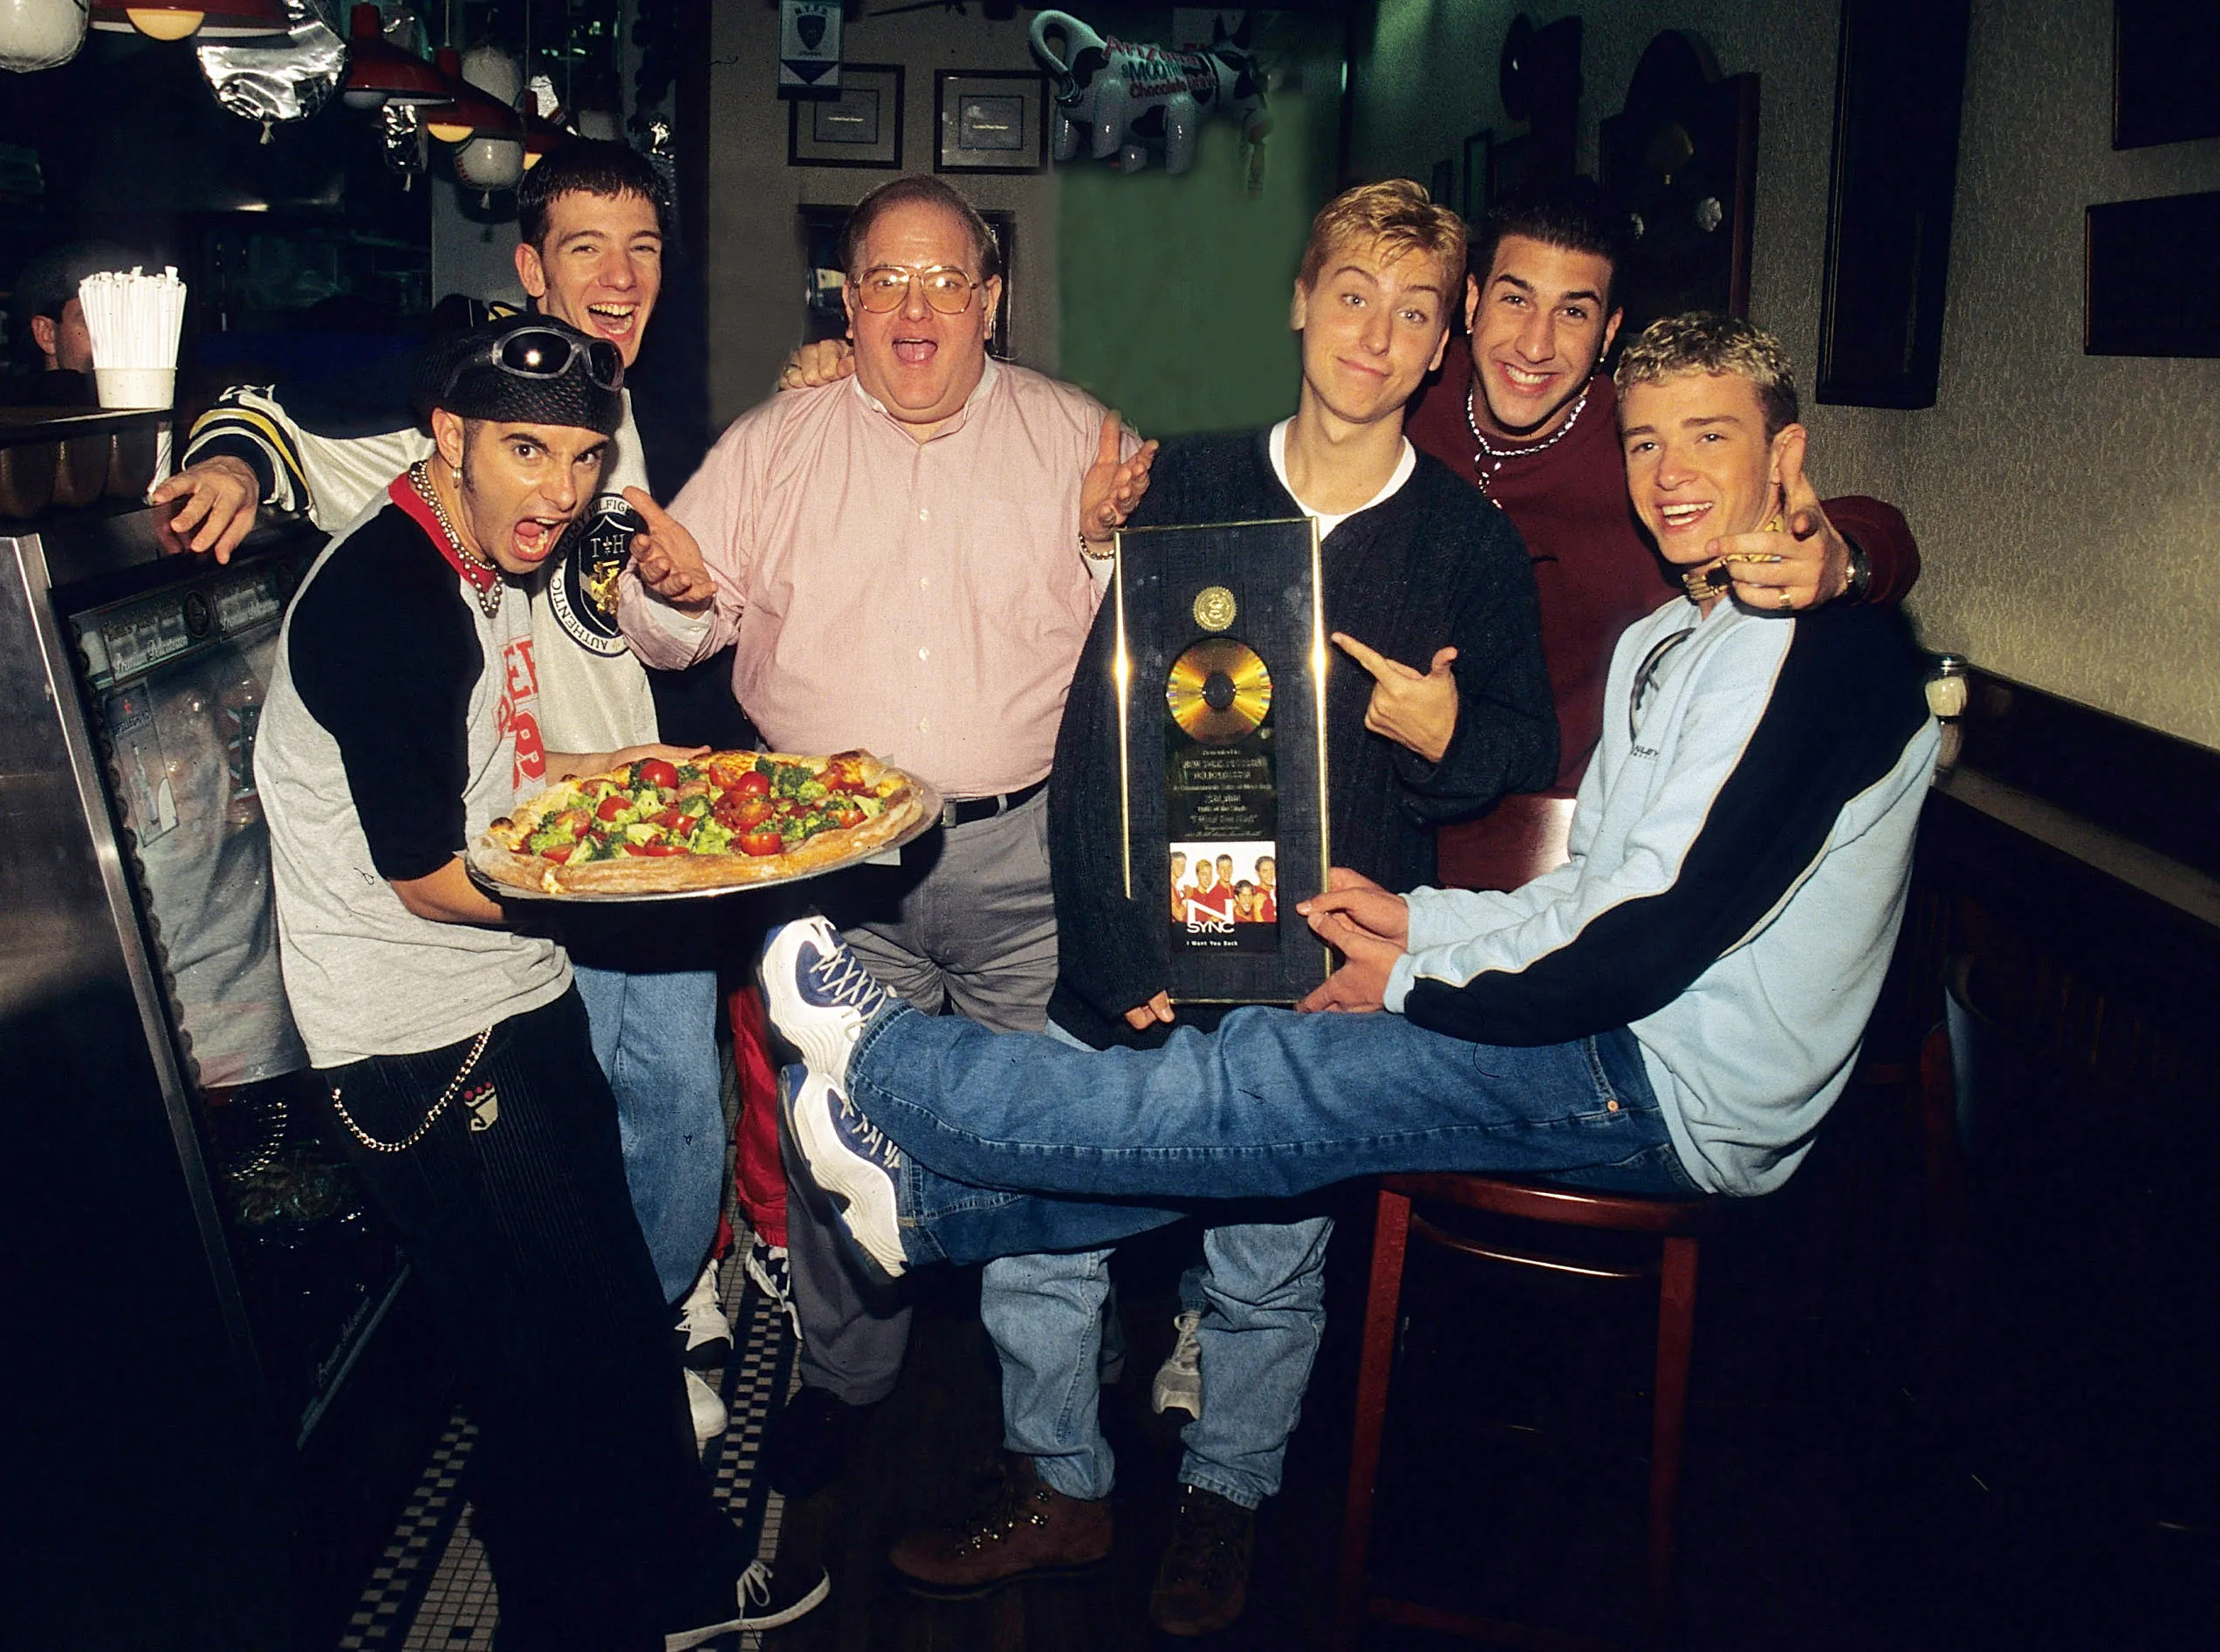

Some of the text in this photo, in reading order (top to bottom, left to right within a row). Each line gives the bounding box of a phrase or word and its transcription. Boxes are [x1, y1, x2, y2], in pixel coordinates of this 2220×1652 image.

[588, 498, 636, 518] HILFIGE
[552, 578, 608, 651] AUTHENTIC
[1187, 922, 1236, 934] SYNC
